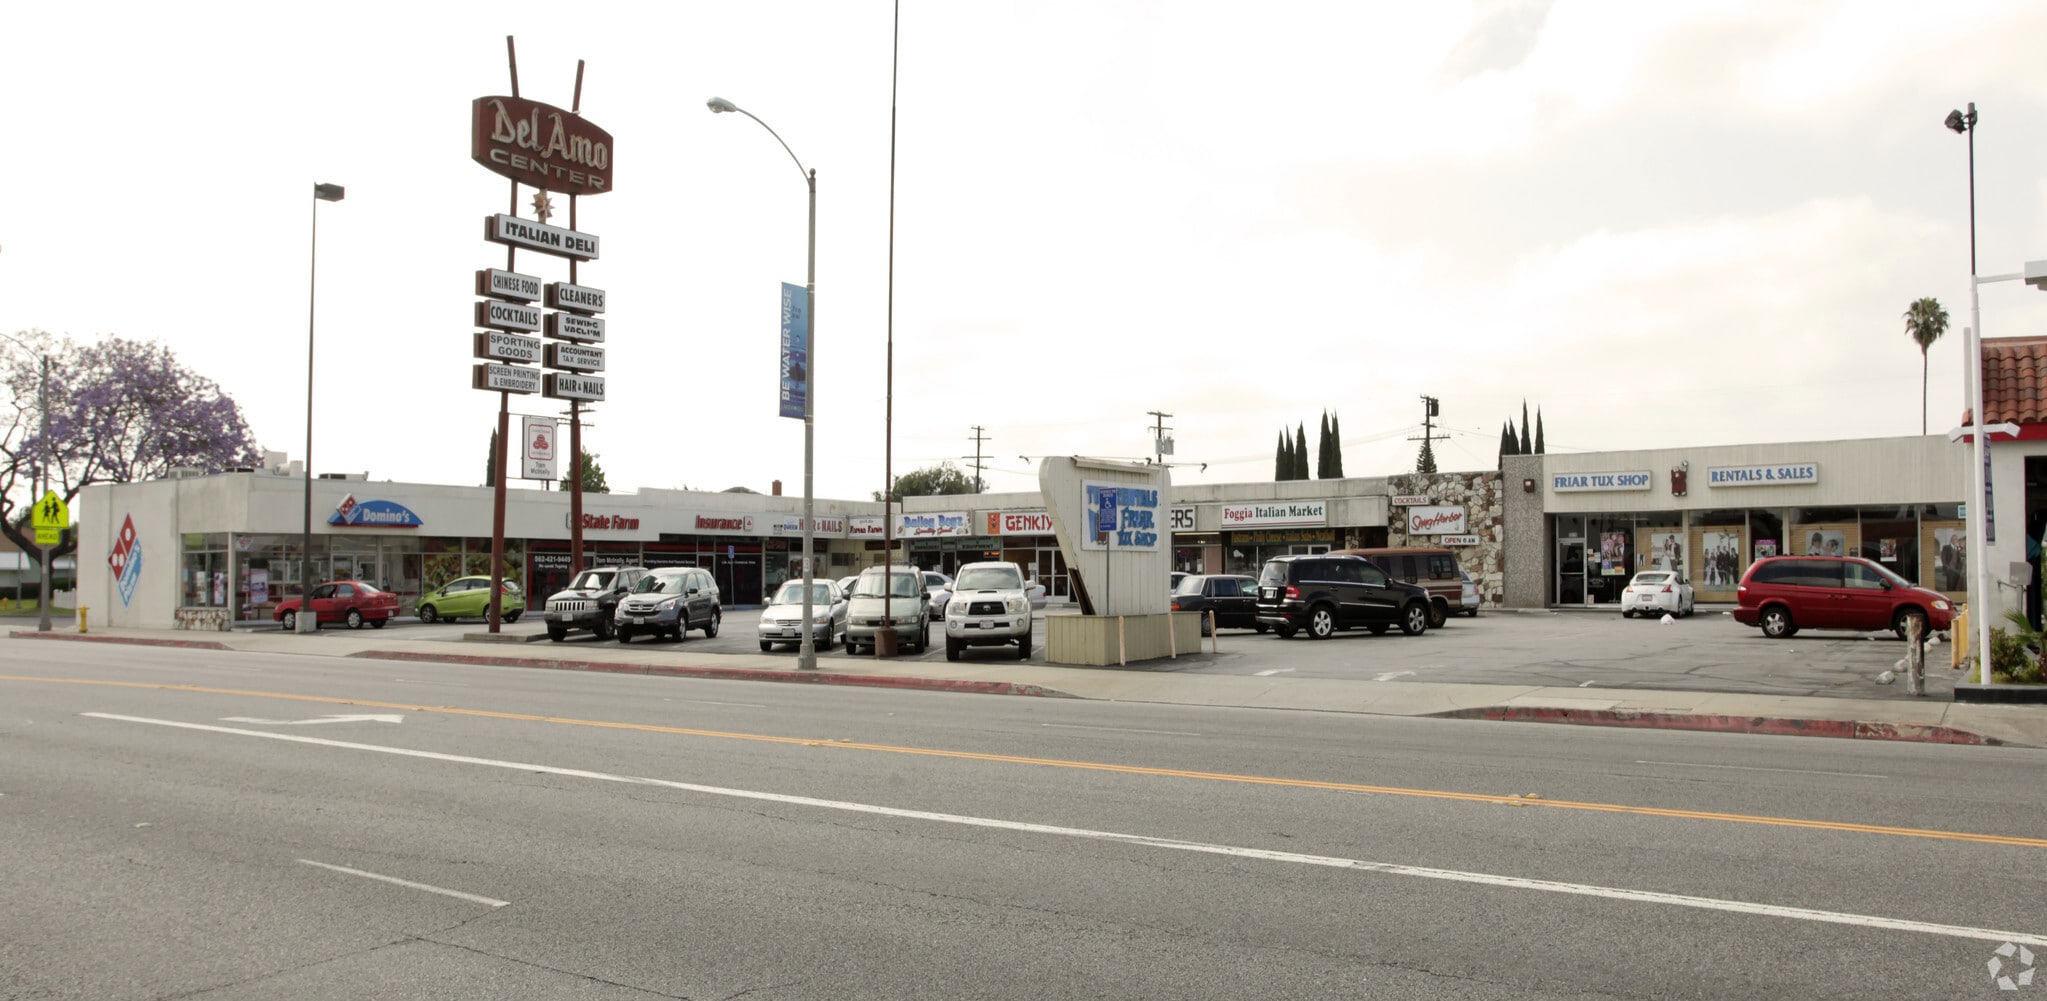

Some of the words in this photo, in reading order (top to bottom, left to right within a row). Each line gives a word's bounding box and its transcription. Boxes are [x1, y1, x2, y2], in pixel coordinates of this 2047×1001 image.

[488, 98, 543, 151] Del
[540, 112, 608, 171] Amo
[490, 148, 605, 190] CENTER
[505, 221, 561, 247] ITALIAN
[565, 235, 596, 254] DELI
[493, 274, 520, 293] CHINESE
[521, 280, 539, 295] FOOD
[559, 288, 603, 307] CLEANERS
[783, 288, 793, 326] WISE
[490, 306, 538, 327] COCKTAILS
[490, 334, 541, 350] SPORTING
[498, 346, 533, 359] GOODS
[560, 346, 603, 359] ACCOUNTANT
[562, 355, 575, 364] TAX
[577, 357, 601, 367] SERVICE
[782, 328, 792, 378] WATER
[489, 366, 512, 379] SCREEN
[513, 368, 541, 381] PRINTING
[493, 377, 499, 386] &
[500, 378, 536, 391] EMBROIDERY
[559, 379, 577, 393] HAIR
[583, 380, 604, 396] NAILS
[781, 380, 791, 401] BE
[1554, 476, 1588, 488] FRIAR
[1591, 475, 1614, 486] TUX
[1617, 474, 1649, 486] SHOP
[1711, 469, 1762, 482] RENTALS
[1765, 468, 1775, 480] &
[1777, 466, 1813, 479] SALES
[1394, 496, 1427, 504] COCKTAILS
[363, 508, 410, 522] Domino's
[582, 513, 610, 529] State
[611, 515, 640, 530] Farm
[695, 515, 743, 529] Insurance
[1120, 507, 1155, 529] FRIAR
[1224, 508, 1253, 522] Foggia
[1255, 506, 1286, 518] Italian
[1288, 505, 1323, 517] Market
[821, 519, 843, 533] NAILS
[1117, 529, 1134, 546] TUX
[1134, 531, 1157, 546] SHOP
